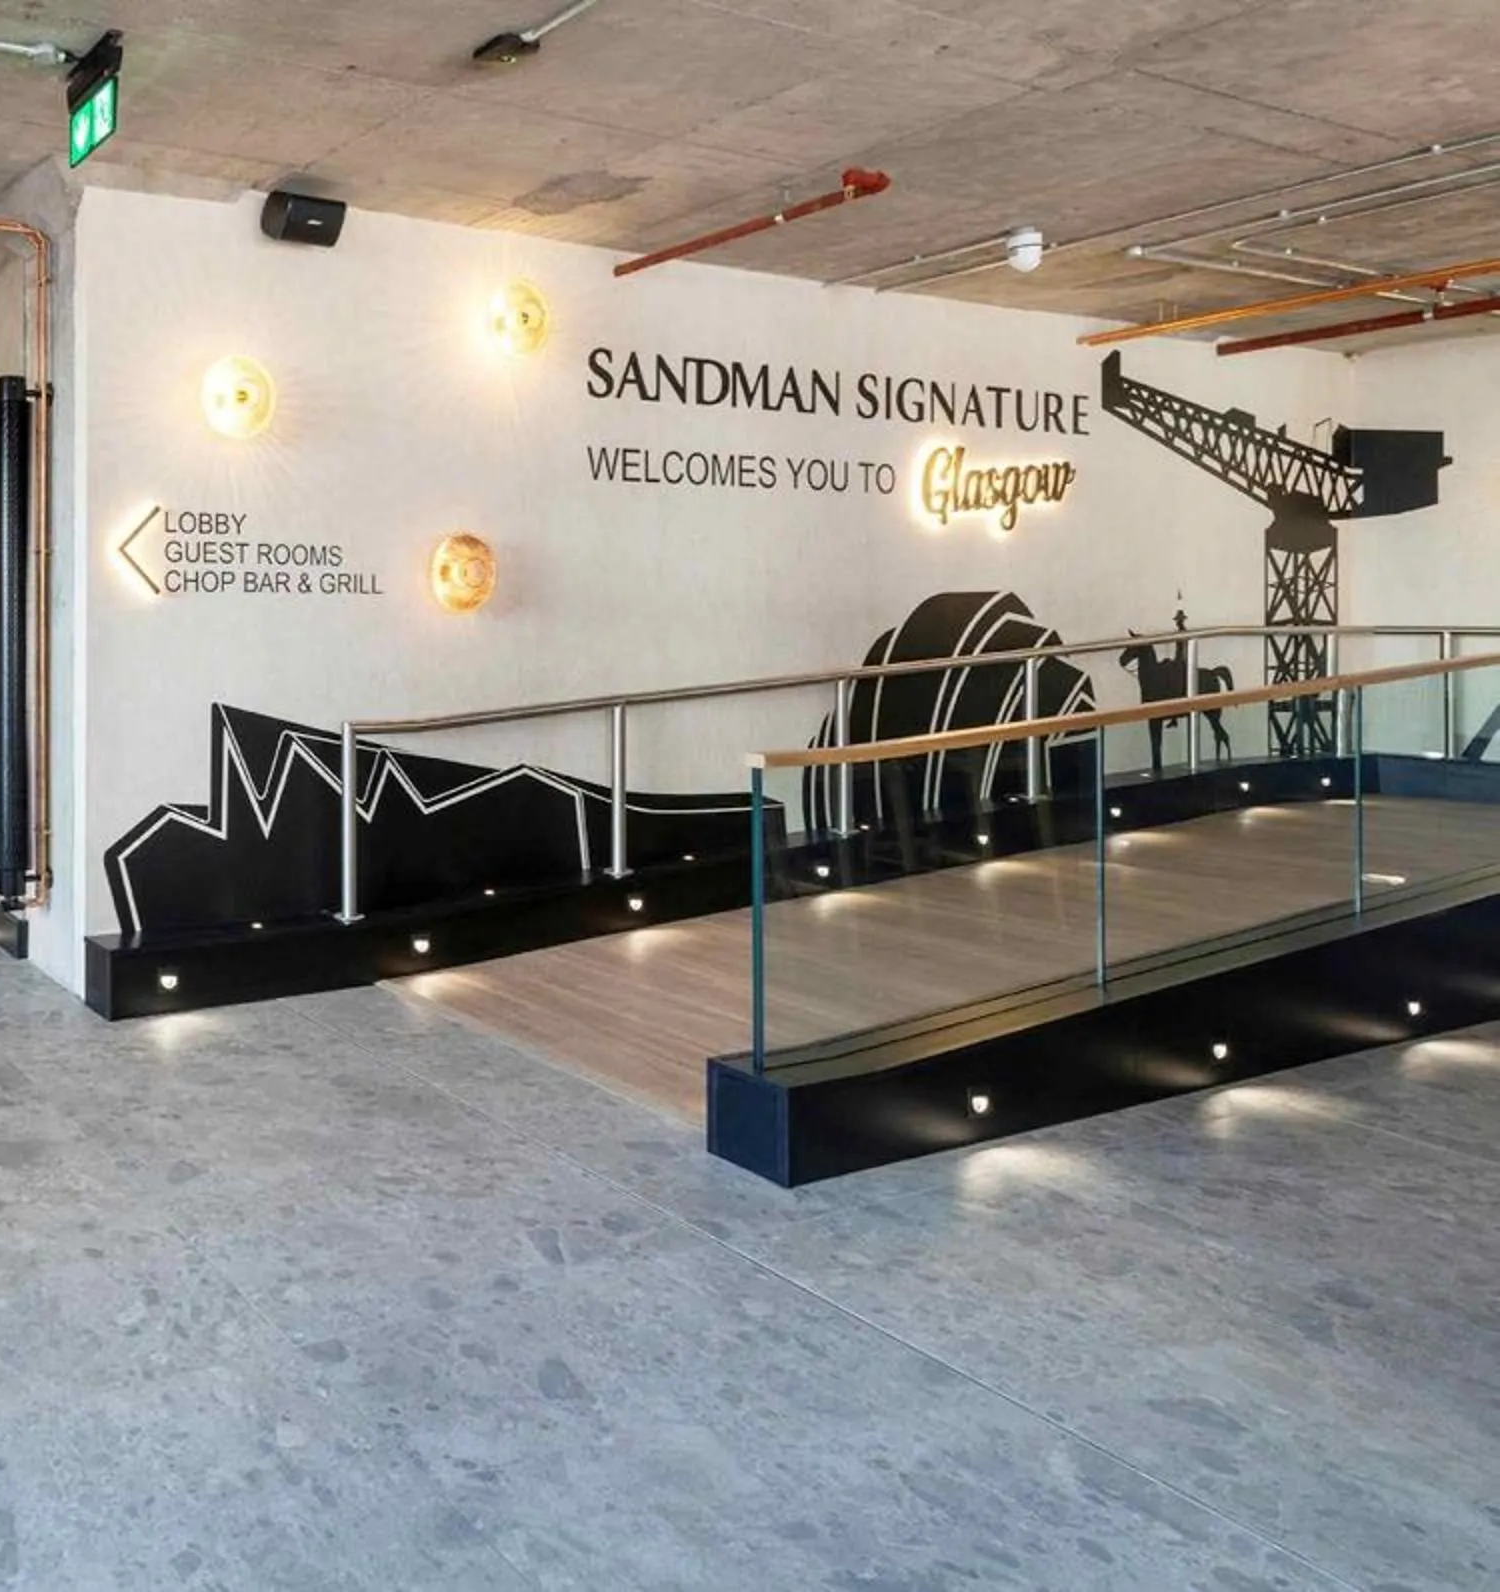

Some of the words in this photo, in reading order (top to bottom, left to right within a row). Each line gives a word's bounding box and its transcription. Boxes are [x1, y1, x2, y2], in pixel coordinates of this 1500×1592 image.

[587, 347, 840, 416] SANDMAN
[856, 373, 1091, 436] SIGNATURE
[587, 446, 777, 490] WELCOMES
[786, 457, 849, 493] YOU
[858, 461, 896, 495] TO
[922, 446, 1076, 530] Glasgow
[164, 511, 247, 535] LOBBY
[164, 540, 250, 565] GUEST
[257, 543, 343, 567] ROOMS
[164, 569, 236, 593] CHOP
[243, 571, 291, 593] BAR
[297, 572, 313, 594] &
[319, 572, 383, 595] GRILL
